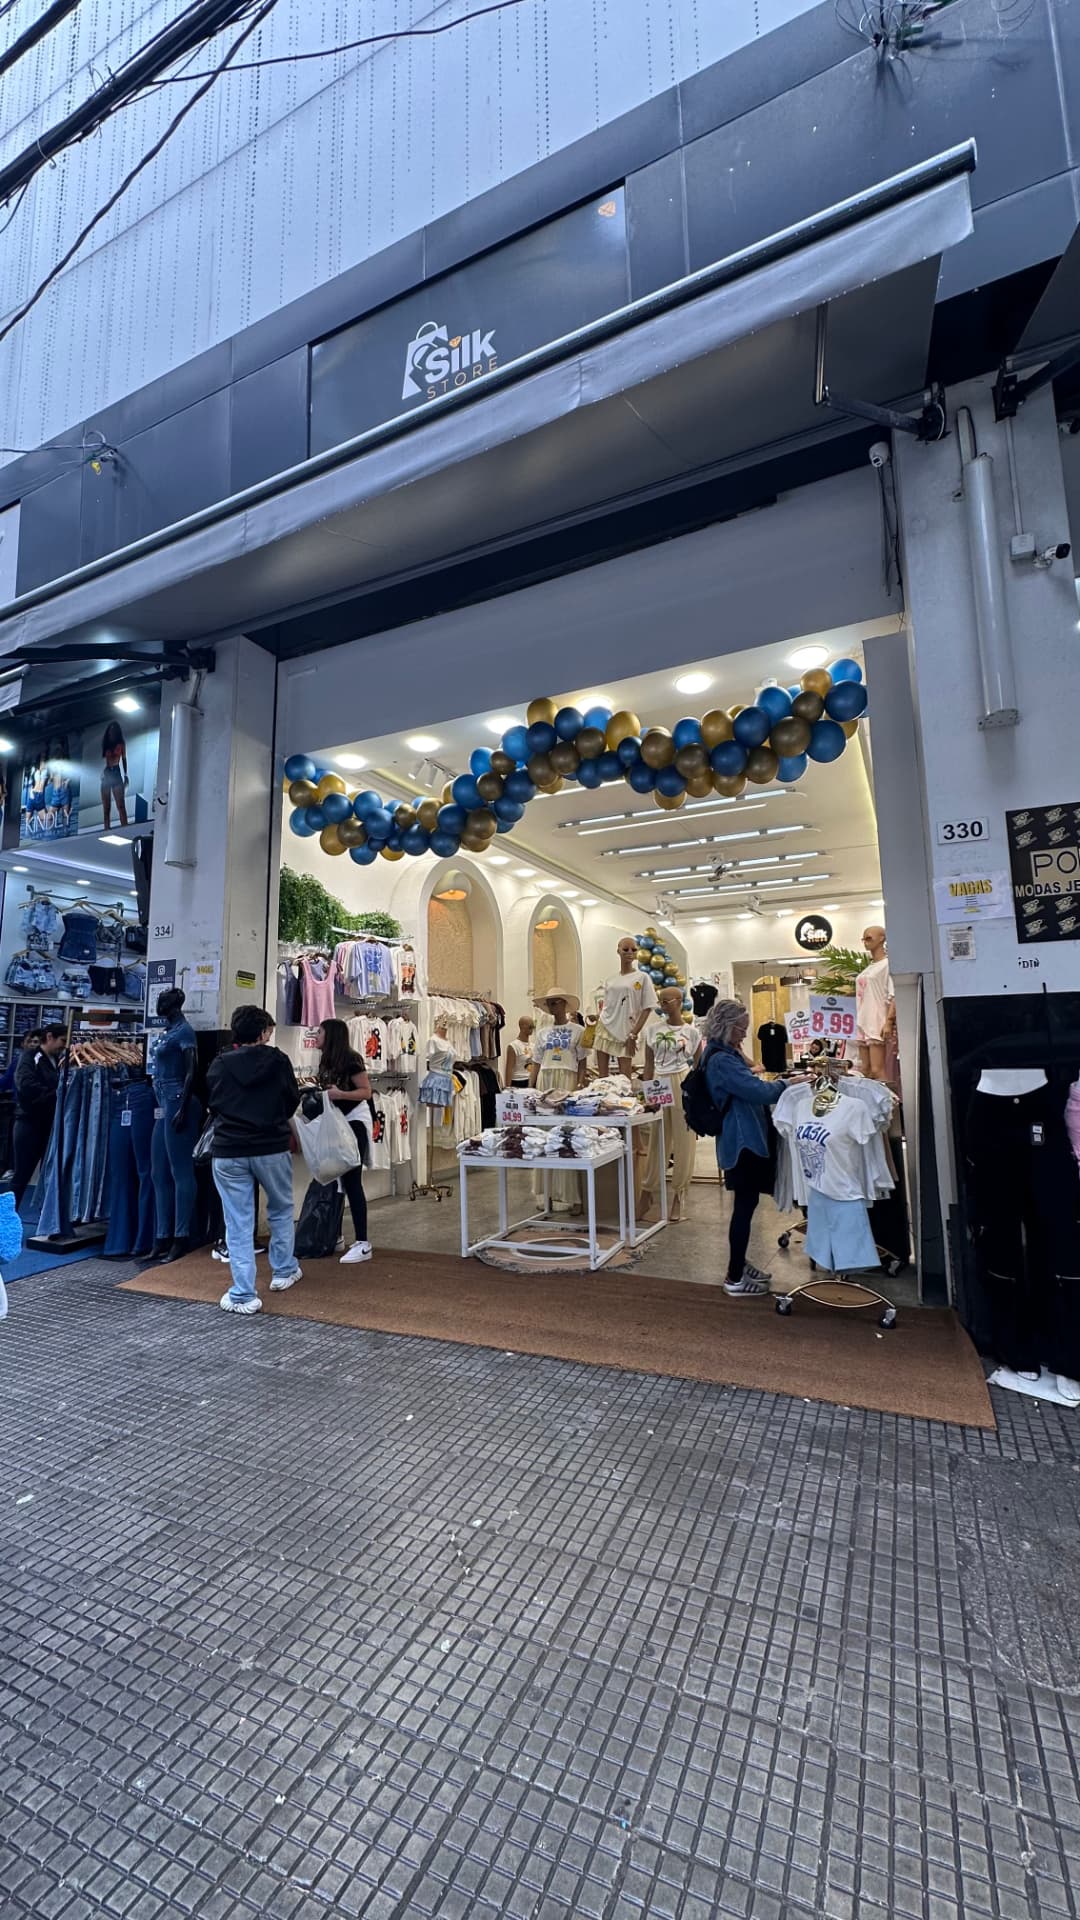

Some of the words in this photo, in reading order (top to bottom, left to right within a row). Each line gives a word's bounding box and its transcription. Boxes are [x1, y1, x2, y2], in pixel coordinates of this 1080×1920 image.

[425, 329, 497, 383] Silk
[427, 356, 499, 399] STORE
[25, 808, 73, 833] KINDLY
[943, 821, 983, 841] 330
[1033, 851, 1080, 878] PO
[949, 880, 993, 896] VAGAS
[1015, 881, 1061, 898] MODAS
[154, 925, 171, 937] 334
[812, 1011, 854, 1035] 8.99
[796, 1125, 831, 1148] RASIL
